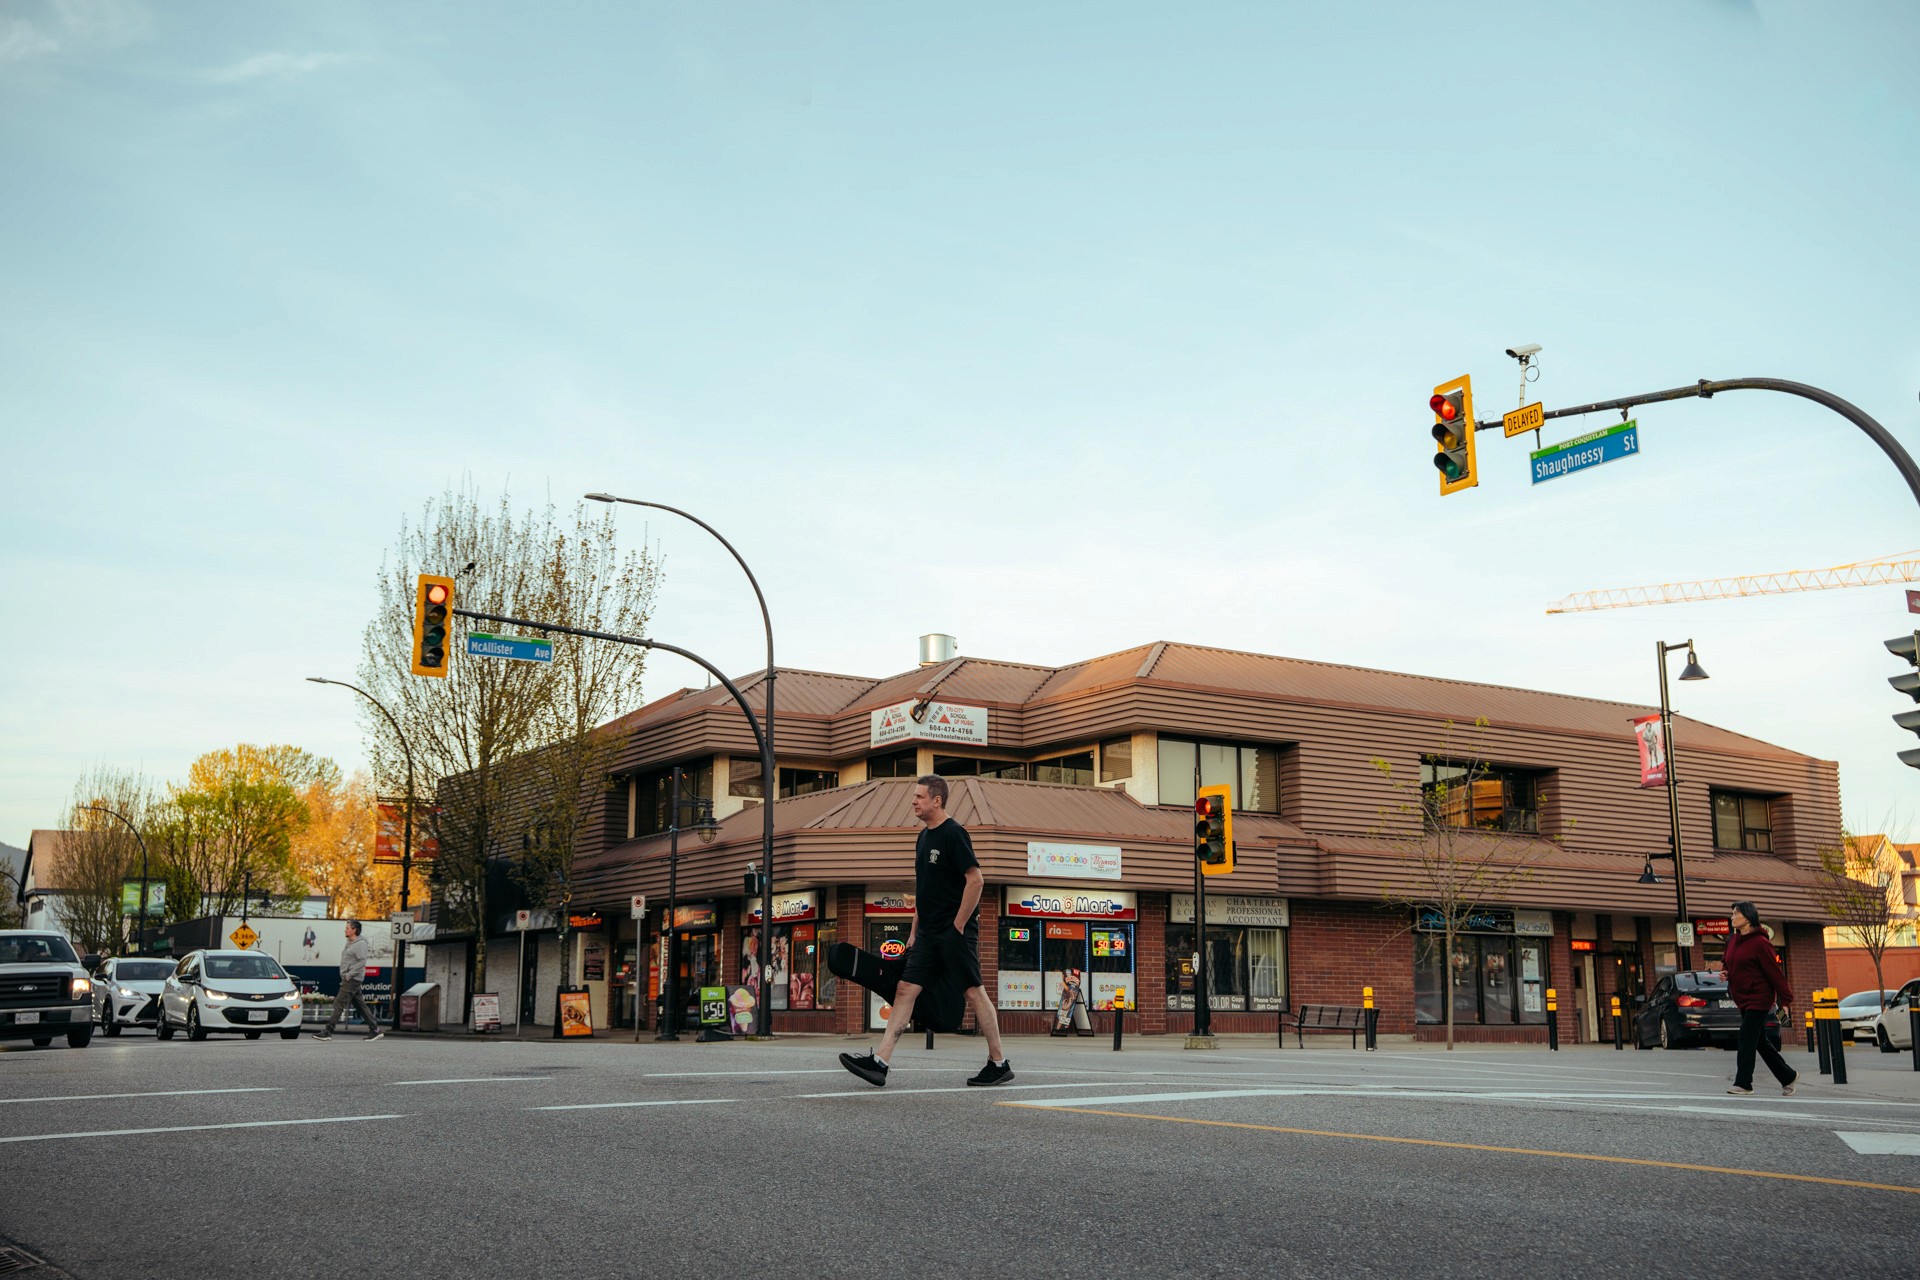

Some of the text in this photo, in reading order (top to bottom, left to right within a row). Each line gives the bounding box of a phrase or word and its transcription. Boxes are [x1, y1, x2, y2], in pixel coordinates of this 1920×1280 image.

[1507, 409, 1539, 432] DELAYED
[1558, 430, 1609, 451] PORT COQUITLAM
[1536, 434, 1636, 478] Shaughnessy St
[471, 641, 550, 659] McAllister Ave
[946, 706, 965, 714] TRI-CITY
[929, 725, 974, 735] 604-474-4766
[920, 731, 983, 743] tricityschoolofmusic.com
[782, 900, 803, 916] Mart
[882, 896, 904, 908] Sun
[1032, 895, 1113, 914] Sun Mart
[1226, 898, 1283, 907] CHARTERED
[1226, 907, 1283, 916] PROFESSIONAL
[1226, 916, 1284, 925] ACCOUNTANT
[393, 922, 412, 935] 30
[1049, 924, 1062, 935] ria
[1011, 931, 1028, 939] OPEN
[882, 944, 903, 953] OPEN
[1098, 940, 1109, 949] 50
[1114, 940, 1125, 950] 50
[1208, 996, 1230, 1009] COLOR
[704, 1001, 725, 1017] $50
